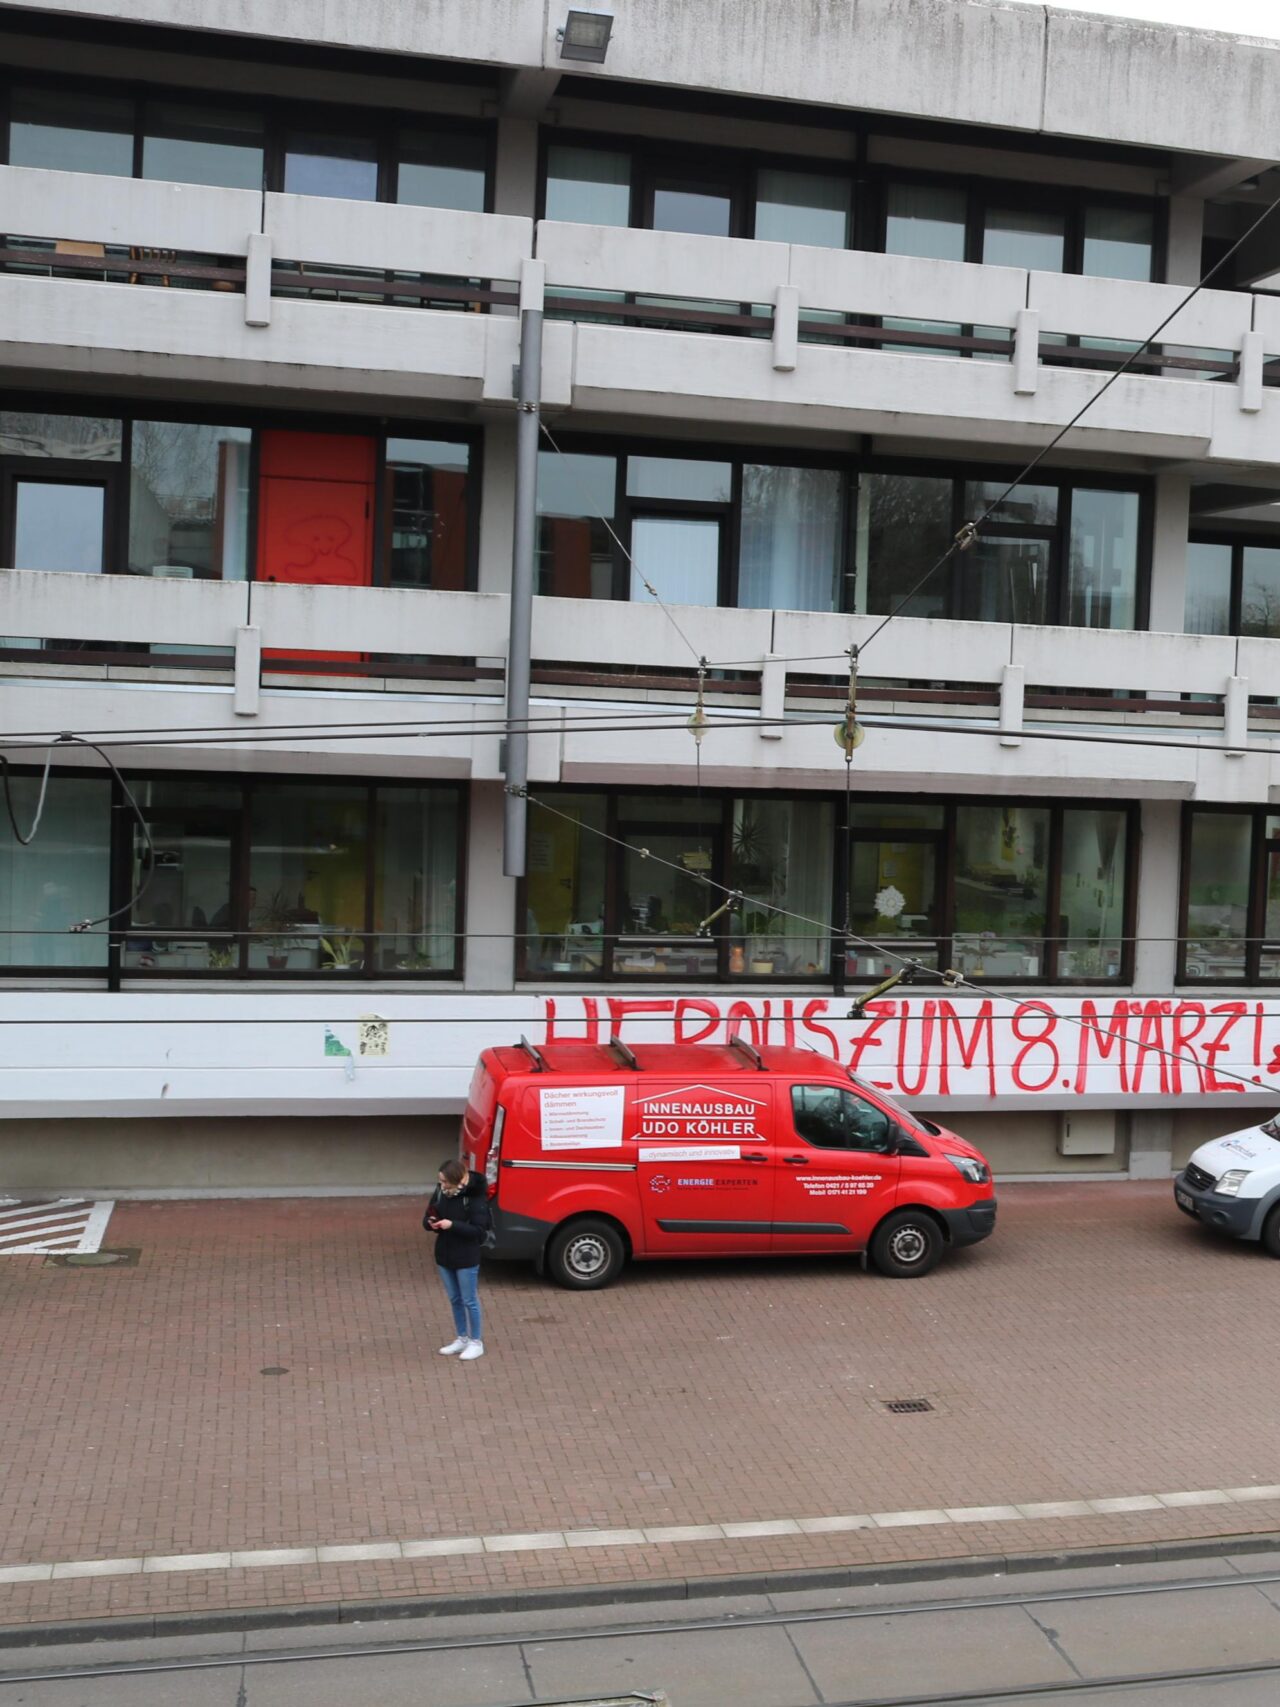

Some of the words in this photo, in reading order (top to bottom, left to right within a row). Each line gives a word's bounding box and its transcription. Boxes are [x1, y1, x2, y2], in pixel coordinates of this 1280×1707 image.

[848, 1000, 997, 1097] ZUM
[1012, 1000, 1070, 1092] 8.
[1074, 999, 1263, 1096] MÄRZ!
[643, 1103, 755, 1115] INNENAUSBAU
[642, 1122, 679, 1134] UDO
[686, 1120, 755, 1135] KÖHLER
[677, 1178, 714, 1186] ENERGIE
